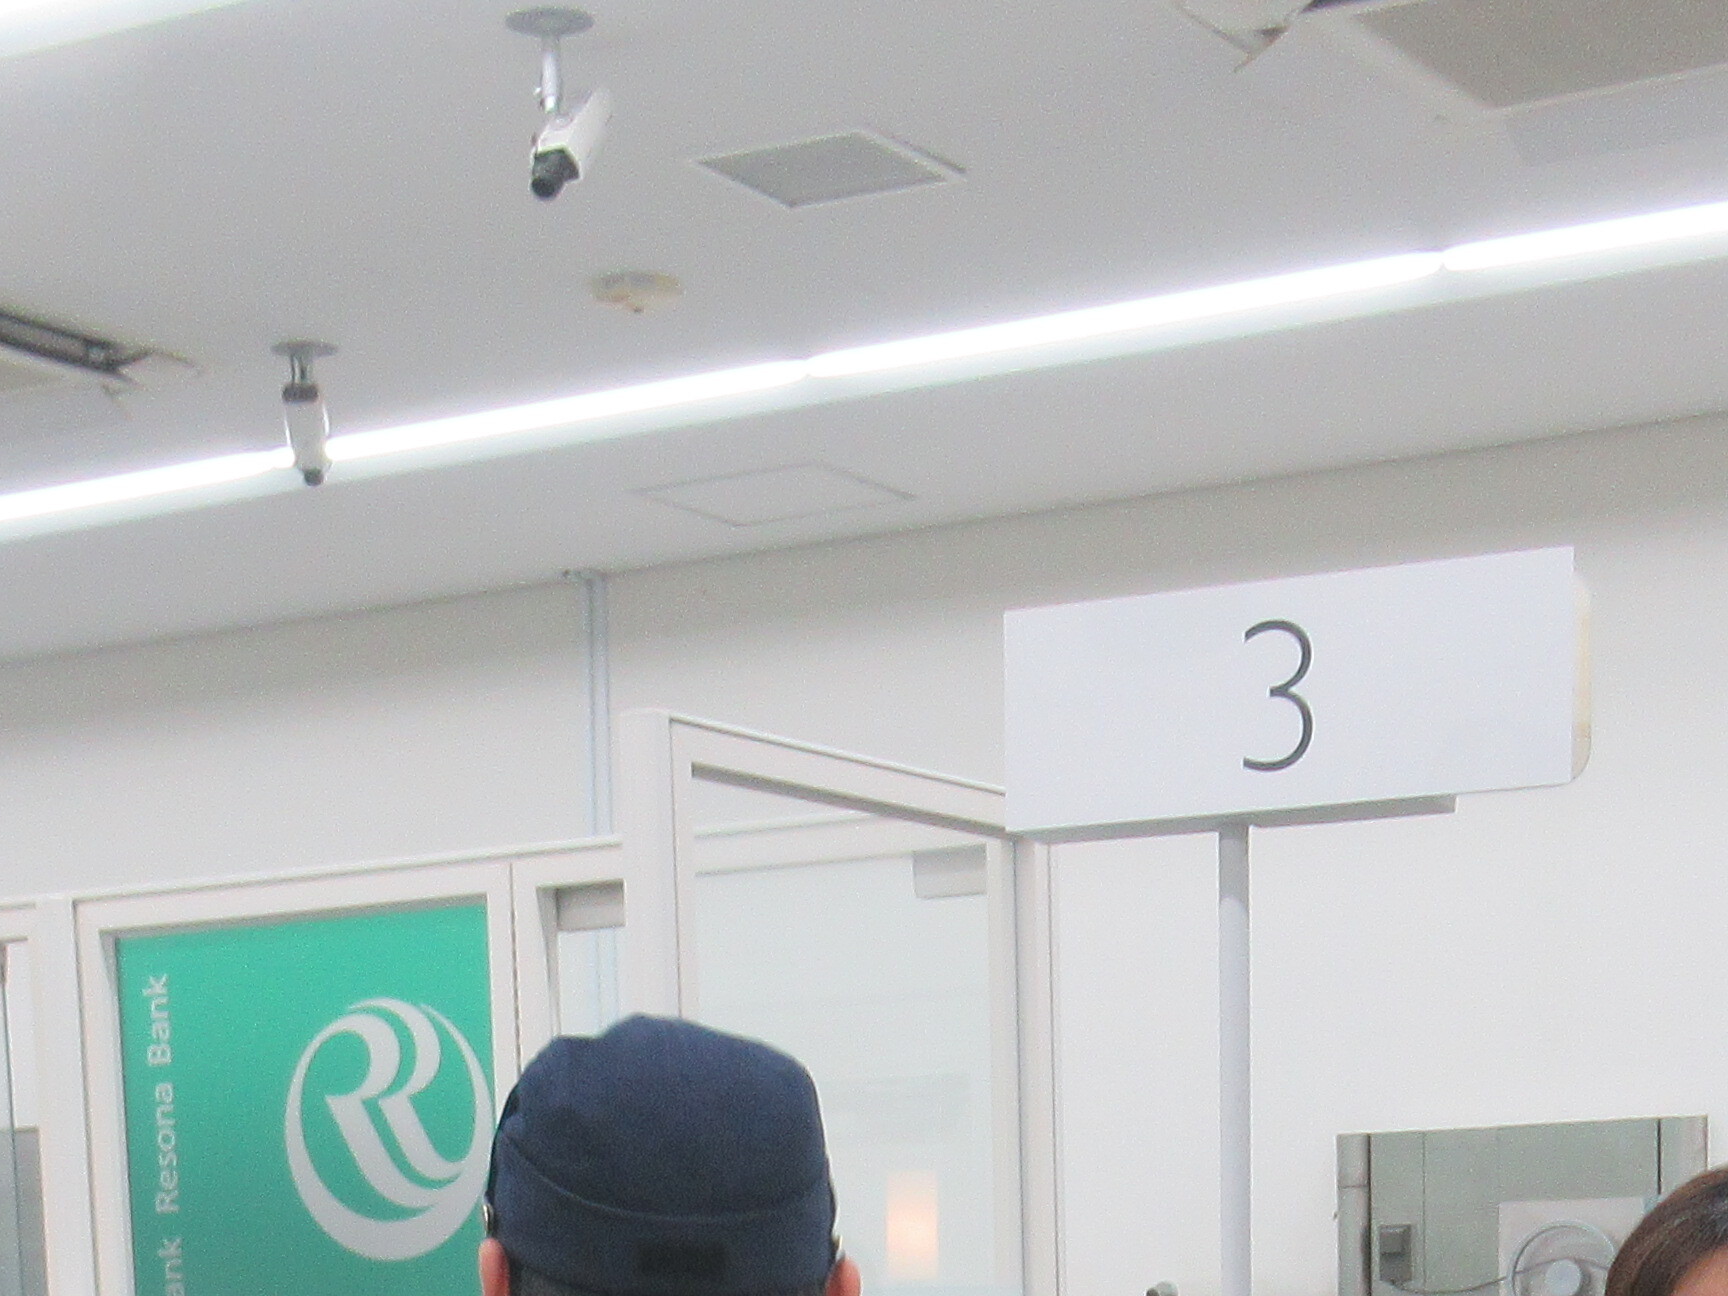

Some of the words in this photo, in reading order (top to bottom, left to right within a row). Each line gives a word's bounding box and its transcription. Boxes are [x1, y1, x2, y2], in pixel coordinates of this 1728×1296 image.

[1242, 618, 1314, 773] 3
[142, 972, 172, 1068] Bank
[155, 1081, 180, 1214] Resona
